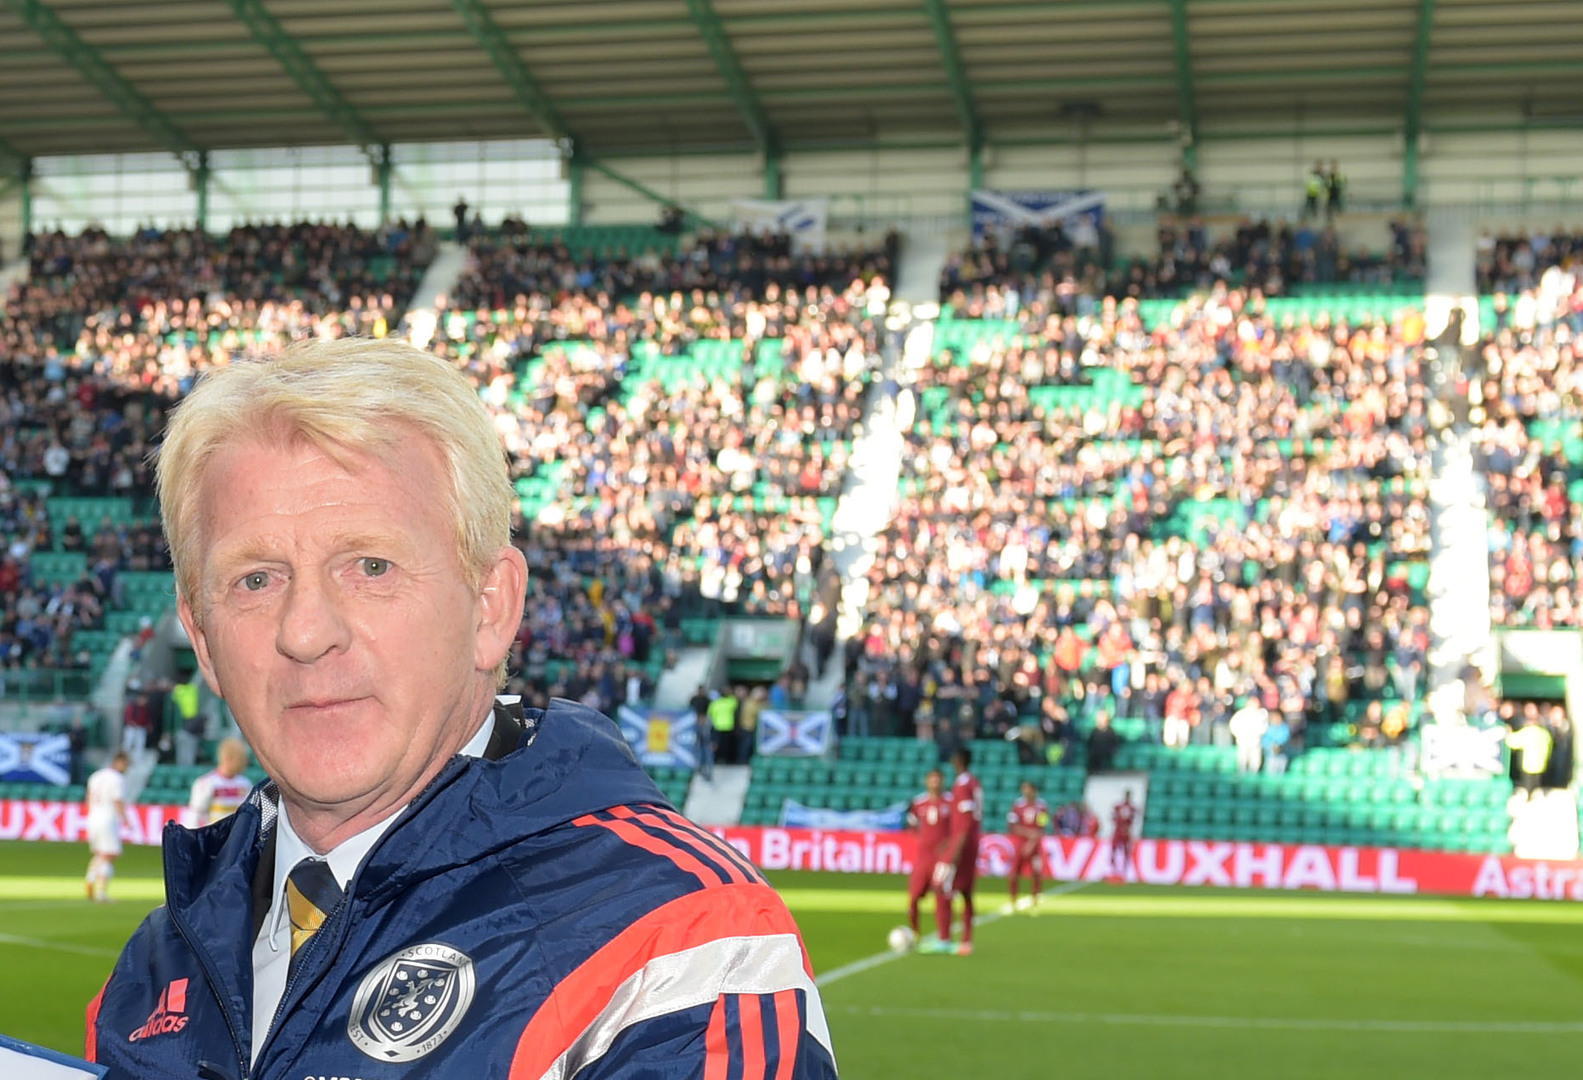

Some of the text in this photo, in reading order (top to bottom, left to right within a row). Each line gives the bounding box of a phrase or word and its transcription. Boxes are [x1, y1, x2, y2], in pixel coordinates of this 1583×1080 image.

[761, 829, 914, 874] Britain.
[1041, 834, 1418, 894] VAUXHALL
[422, 1034, 444, 1053] 1873
